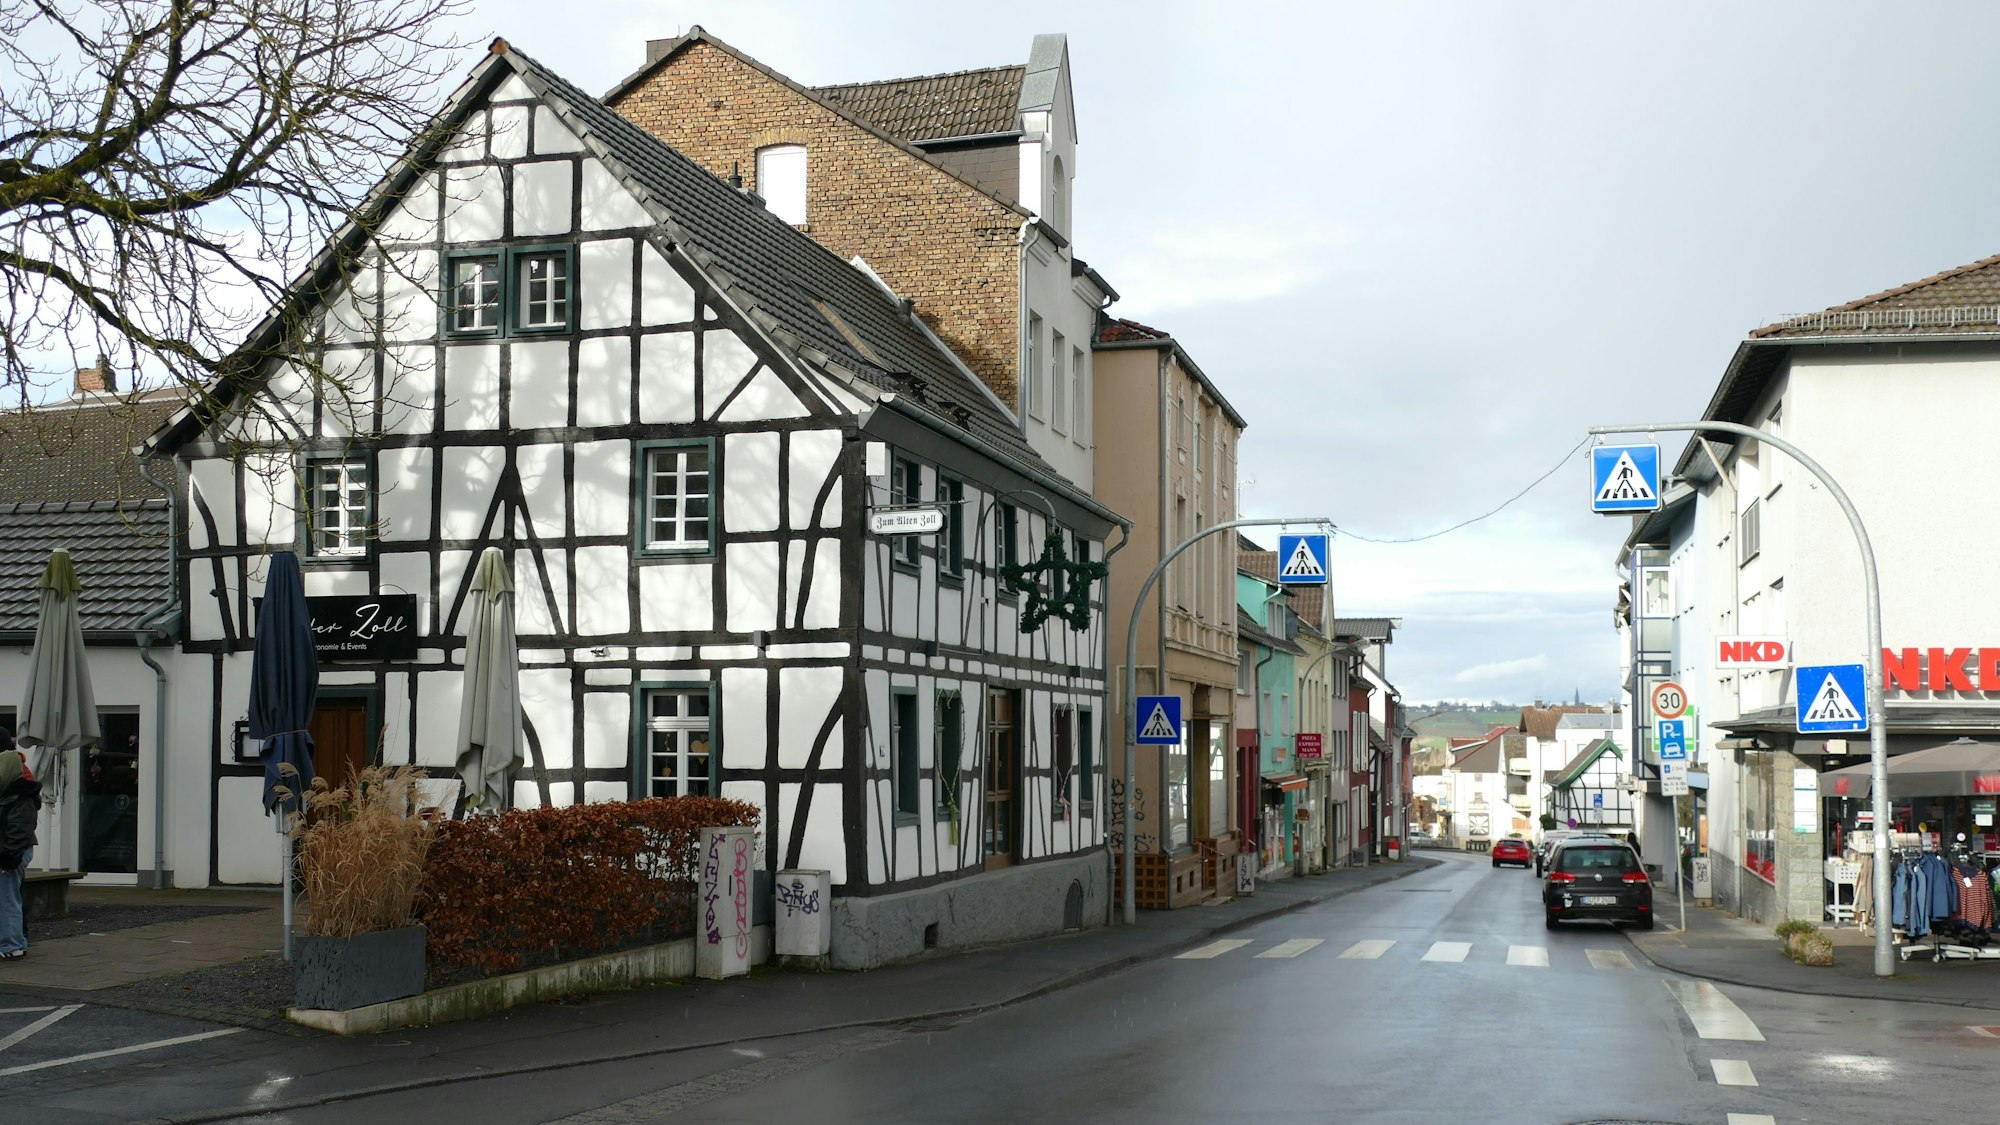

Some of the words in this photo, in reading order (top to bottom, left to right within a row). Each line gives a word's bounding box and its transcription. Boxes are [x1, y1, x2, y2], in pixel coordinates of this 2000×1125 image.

[876, 517, 894, 529] Zum
[920, 514, 936, 527] Zoll
[350, 603, 408, 640] Zoll
[341, 642, 346, 650] &
[347, 642, 367, 650] Events
[1720, 641, 1785, 662] NKD
[1660, 693, 1680, 709] 30
[1662, 722, 1674, 739] P
